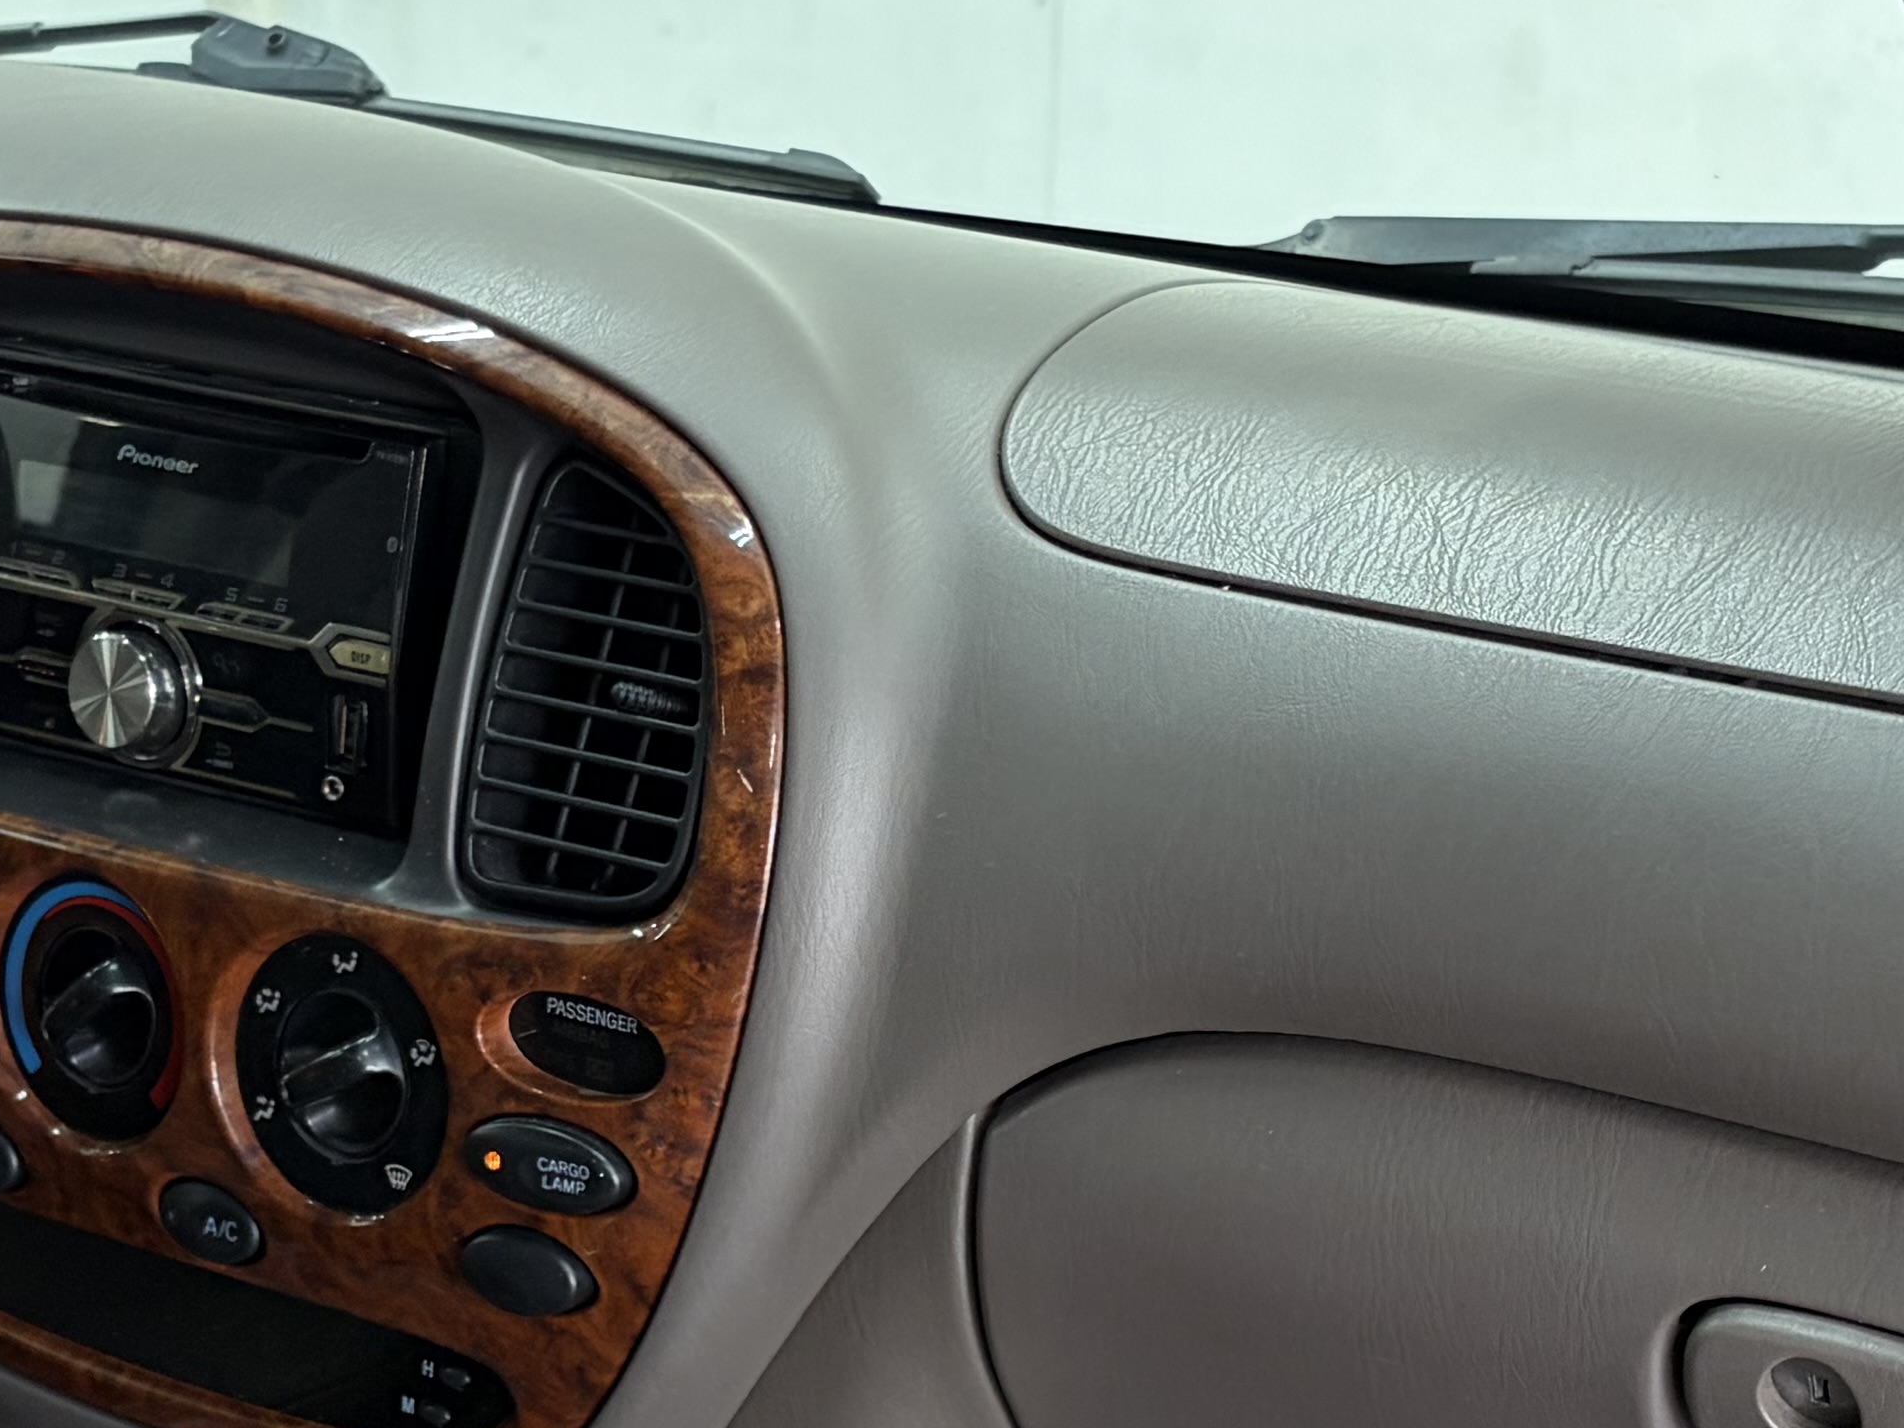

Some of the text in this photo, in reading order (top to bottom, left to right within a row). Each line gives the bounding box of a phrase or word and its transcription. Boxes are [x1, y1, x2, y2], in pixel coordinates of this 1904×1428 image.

[116, 443, 199, 475] Pioneer
[112, 563, 175, 589] 3 4
[223, 587, 289, 613] 5 6
[546, 996, 639, 1035] PASSENGER
[537, 1156, 590, 1181] CARGO
[542, 1175, 586, 1195] LAMP
[203, 1216, 239, 1243] A/C
[421, 1359, 434, 1378] H
[401, 1395, 415, 1415] M
